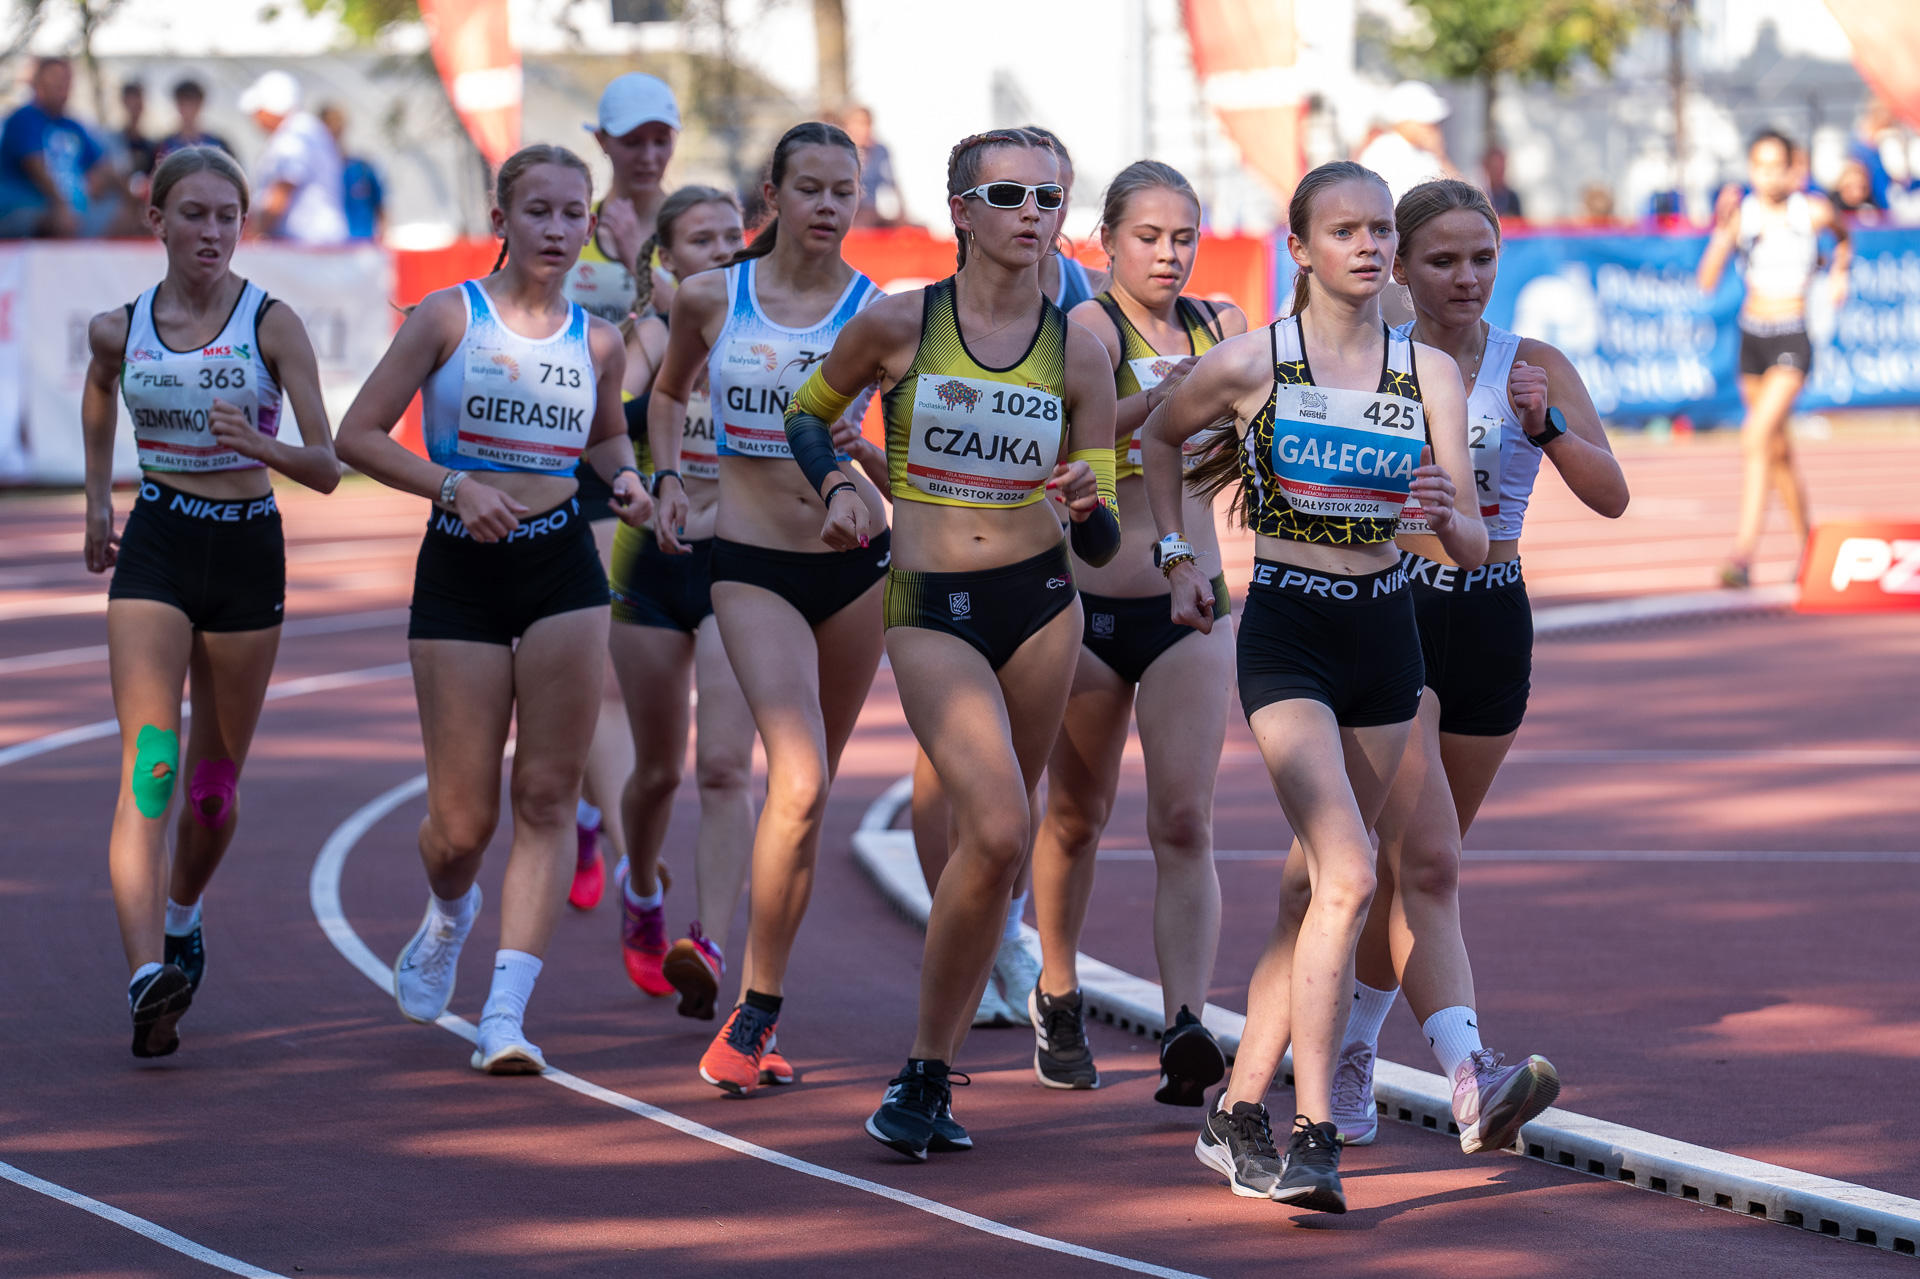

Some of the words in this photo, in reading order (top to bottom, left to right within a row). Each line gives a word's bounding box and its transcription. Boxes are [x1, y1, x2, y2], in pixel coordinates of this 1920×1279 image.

[203, 345, 231, 356] MKS
[799, 350, 815, 372] 7
[142, 374, 184, 388] FUEL
[198, 368, 246, 389] 363
[539, 362, 581, 389] 713
[467, 395, 585, 433] GIERASIK
[918, 401, 947, 411] Podlaskie
[992, 390, 1059, 421] 1028
[1363, 401, 1415, 431] 425
[134, 404, 253, 433] SZMYTKOA
[738, 440, 793, 454] BIAŁYSTO
[924, 426, 1043, 467] CZAJKA
[1469, 425, 1486, 449] 2
[155, 454, 210, 468] BIAŁYSTOK
[212, 454, 239, 466] 2024
[477, 447, 538, 466] BIAŁYSTOK
[539, 456, 562, 467] 2024
[1277, 434, 1413, 481] GAŁECKA
[929, 482, 995, 500] BIAŁYSTOK
[996, 492, 1025, 501] 2024
[169, 493, 243, 522] NIKE
[1291, 496, 1352, 513] BIAŁYSTOK
[1353, 502, 1380, 513] 2024
[1278, 569, 1358, 600] PRO
[1464, 559, 1520, 592] PRO
